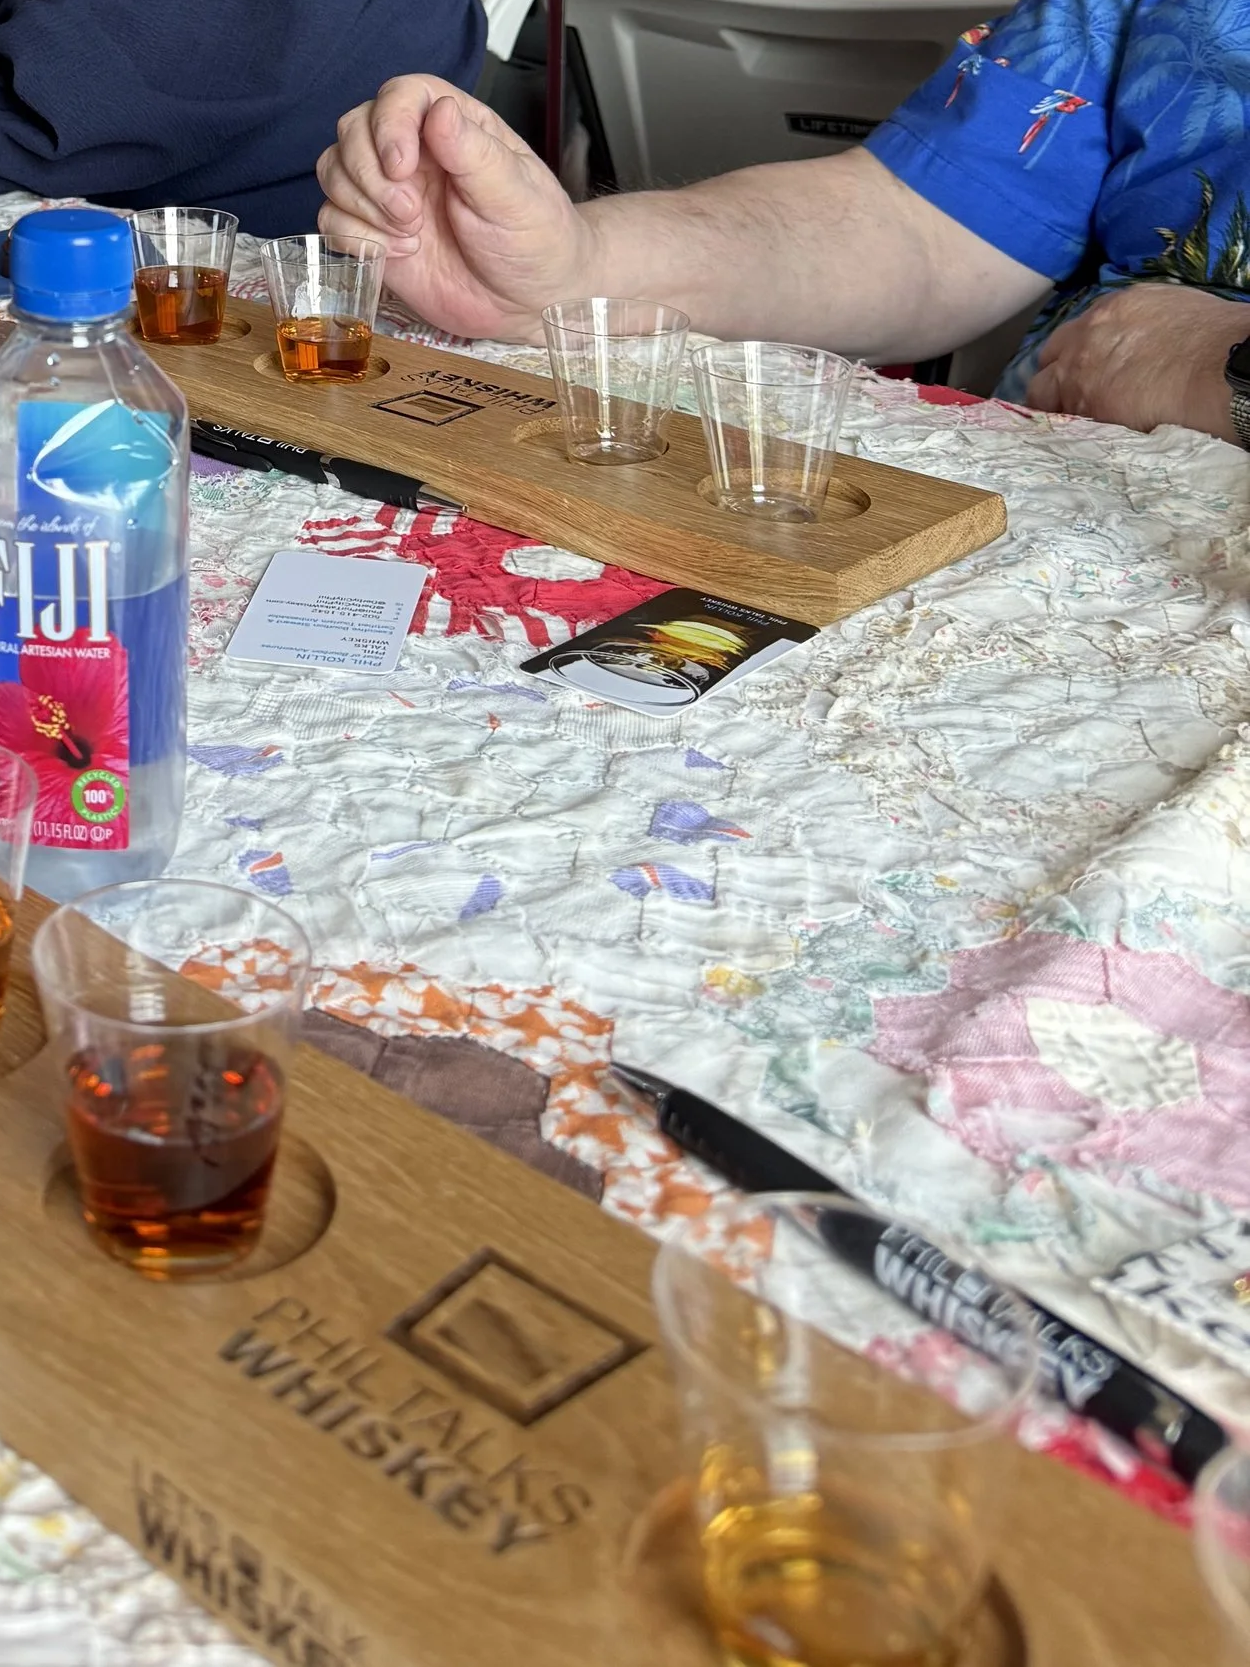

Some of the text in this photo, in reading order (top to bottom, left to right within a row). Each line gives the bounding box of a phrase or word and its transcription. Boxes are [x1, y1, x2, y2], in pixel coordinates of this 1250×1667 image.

[418, 370, 557, 409] WHISKEY
[487, 393, 546, 415] PHIL
[17, 513, 38, 531] the
[340, 637, 389, 645] WHISKEY
[21, 644, 72, 658] ARTESIAN
[75, 647, 111, 659] WATER
[296, 653, 382, 666] PHIL KOLLIN
[77, 771, 121, 788] RECYCLED
[251, 1296, 593, 1526] PHIL TALKS
[218, 1327, 556, 1555] WHISKEY
[137, 1492, 350, 1667] WHISKE
